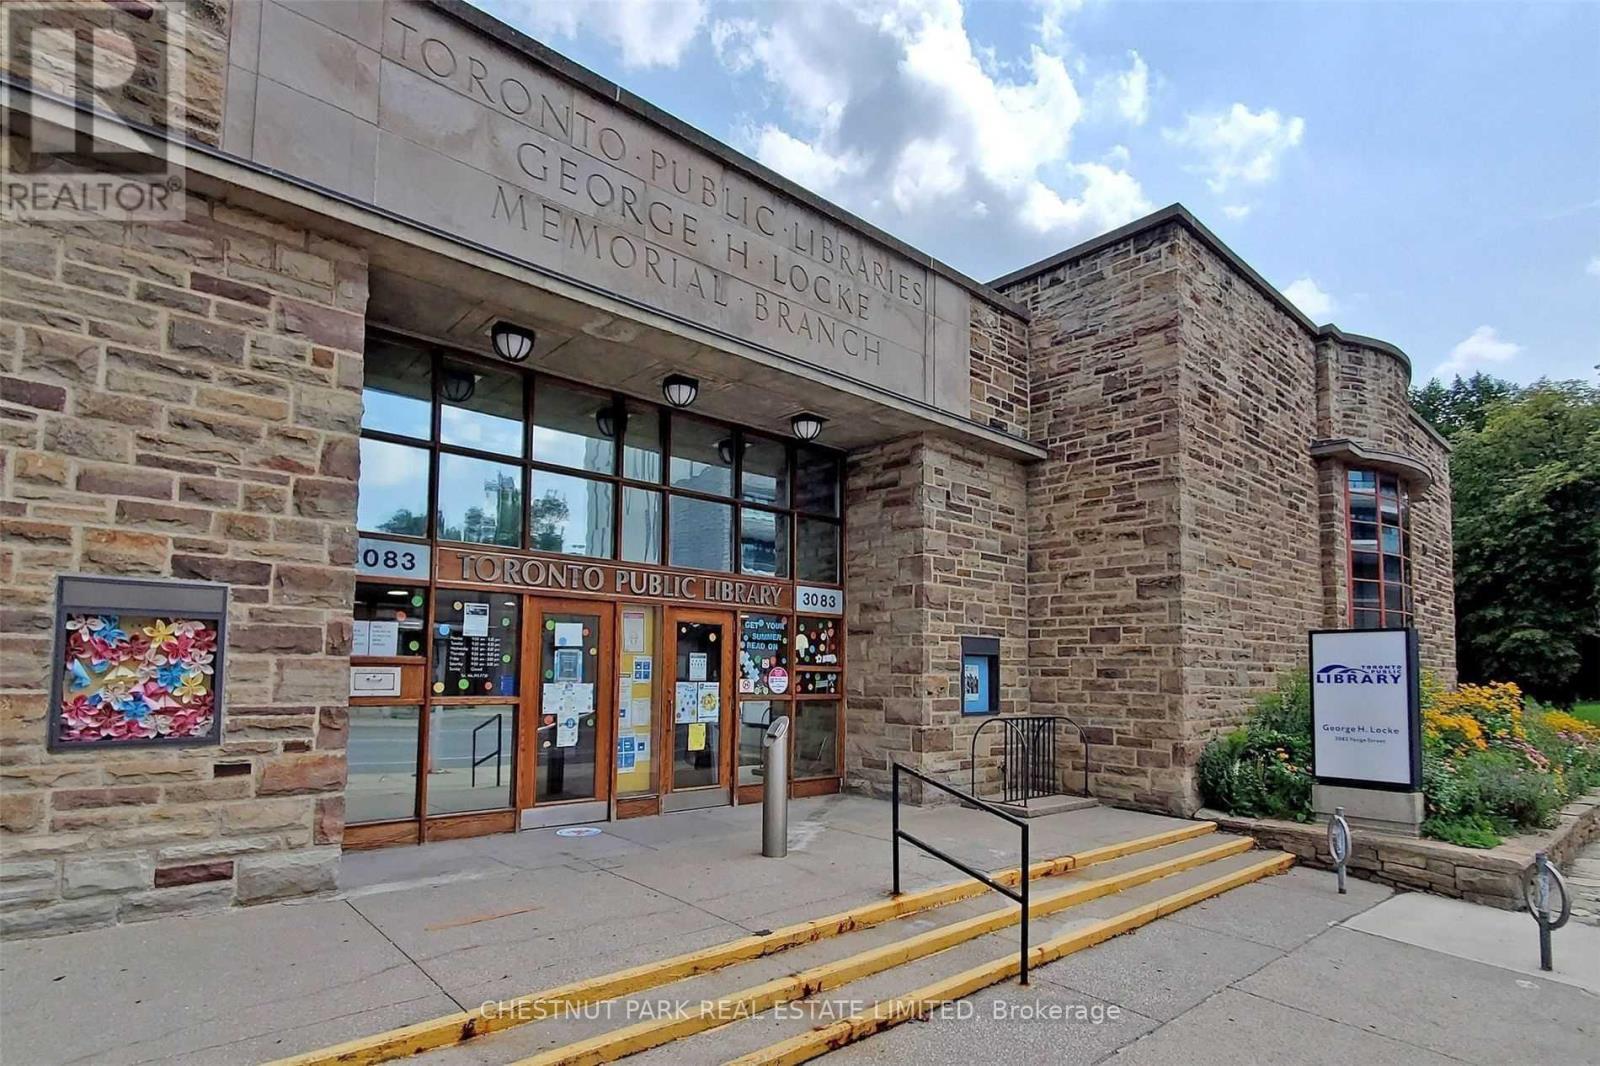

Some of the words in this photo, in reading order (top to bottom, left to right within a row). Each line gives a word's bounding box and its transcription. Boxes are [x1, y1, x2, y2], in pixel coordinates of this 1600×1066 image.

[390, 16, 627, 162] TORONTO
[651, 148, 776, 237] PUBLIC
[793, 221, 923, 306] LIBRARIES
[516, 141, 698, 247] GEORGE
[726, 233, 748, 269] H
[772, 254, 870, 321] LOCKE
[490, 185, 728, 307] MEMORIAL
[754, 291, 881, 366] BRANCH
[356, 548, 417, 572] 083
[457, 552, 605, 592] TORONTO
[615, 569, 697, 599] PUBLIC
[703, 579, 783, 606] LIBRARY
[802, 592, 837, 608] 3083
[744, 621, 759, 629] GET
[1316, 674, 1401, 684] LIBRARY
[1322, 724, 1356, 734] George
[1370, 726, 1400, 734] Locke
